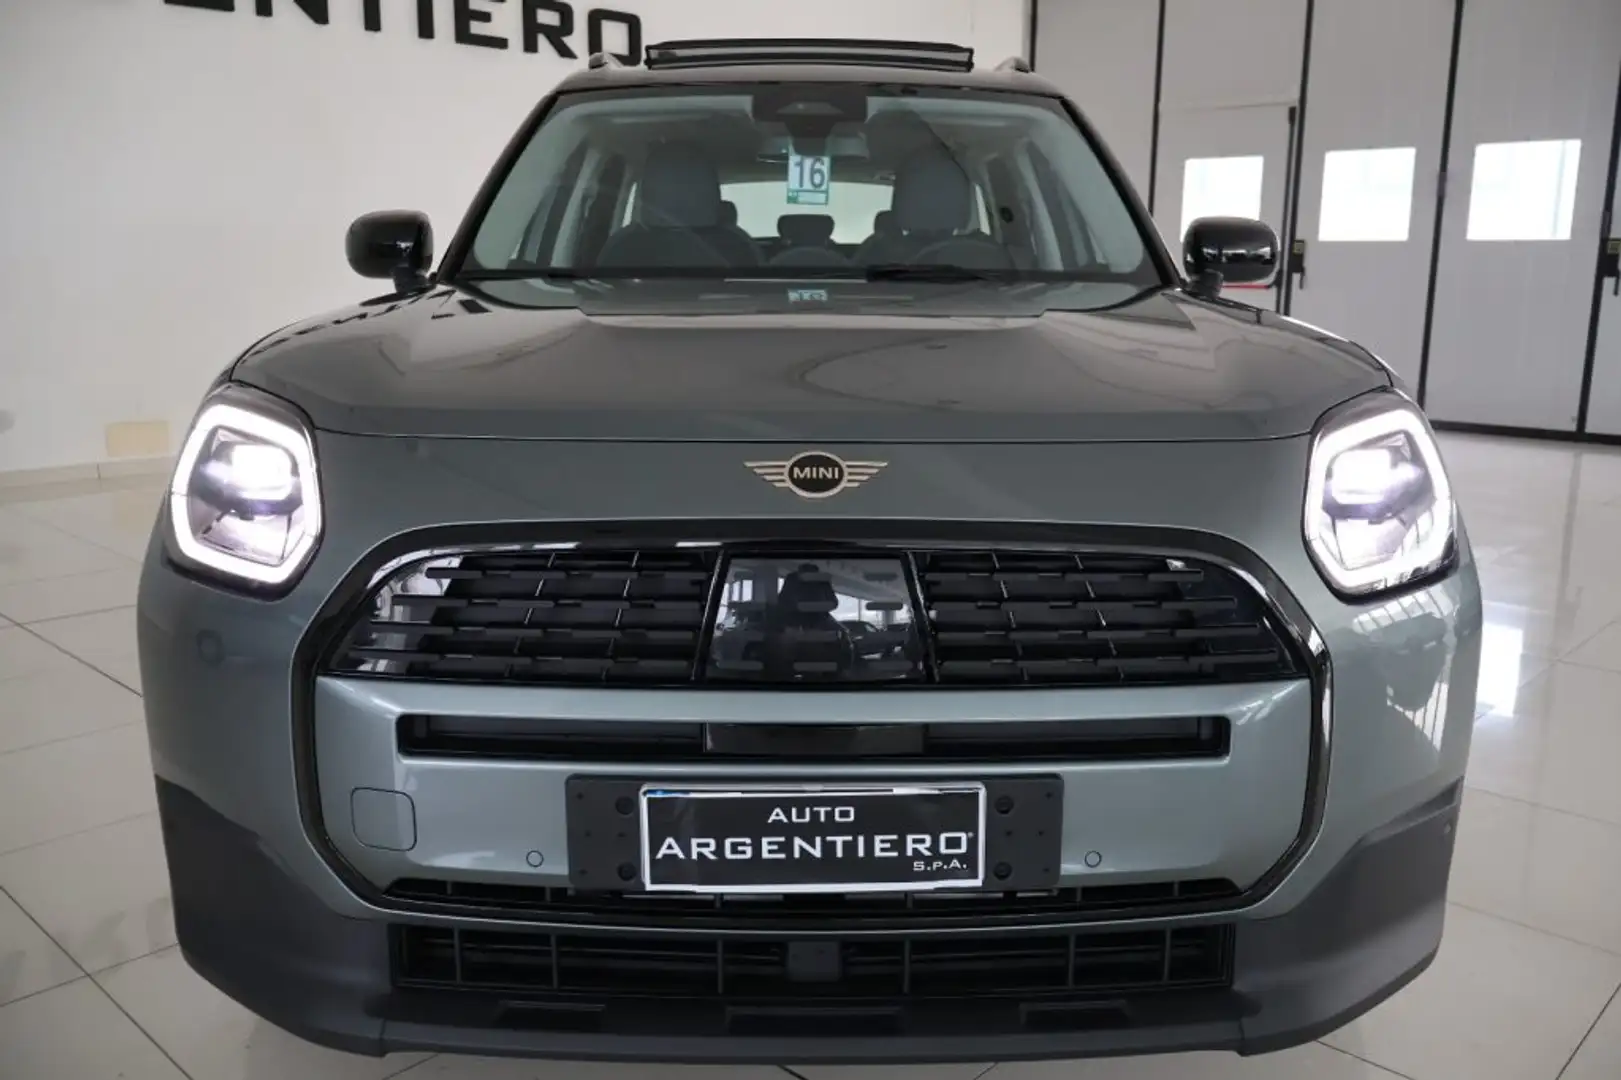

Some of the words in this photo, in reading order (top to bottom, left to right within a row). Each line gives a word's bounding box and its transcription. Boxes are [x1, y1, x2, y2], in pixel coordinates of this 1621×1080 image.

[164, 0, 642, 66] IERO
[794, 156, 826, 189] 16
[792, 466, 840, 480] MINI
[767, 806, 855, 823] AUTO
[655, 831, 968, 860] ARGENTIERO
[912, 858, 968, 872] S.P.A.
